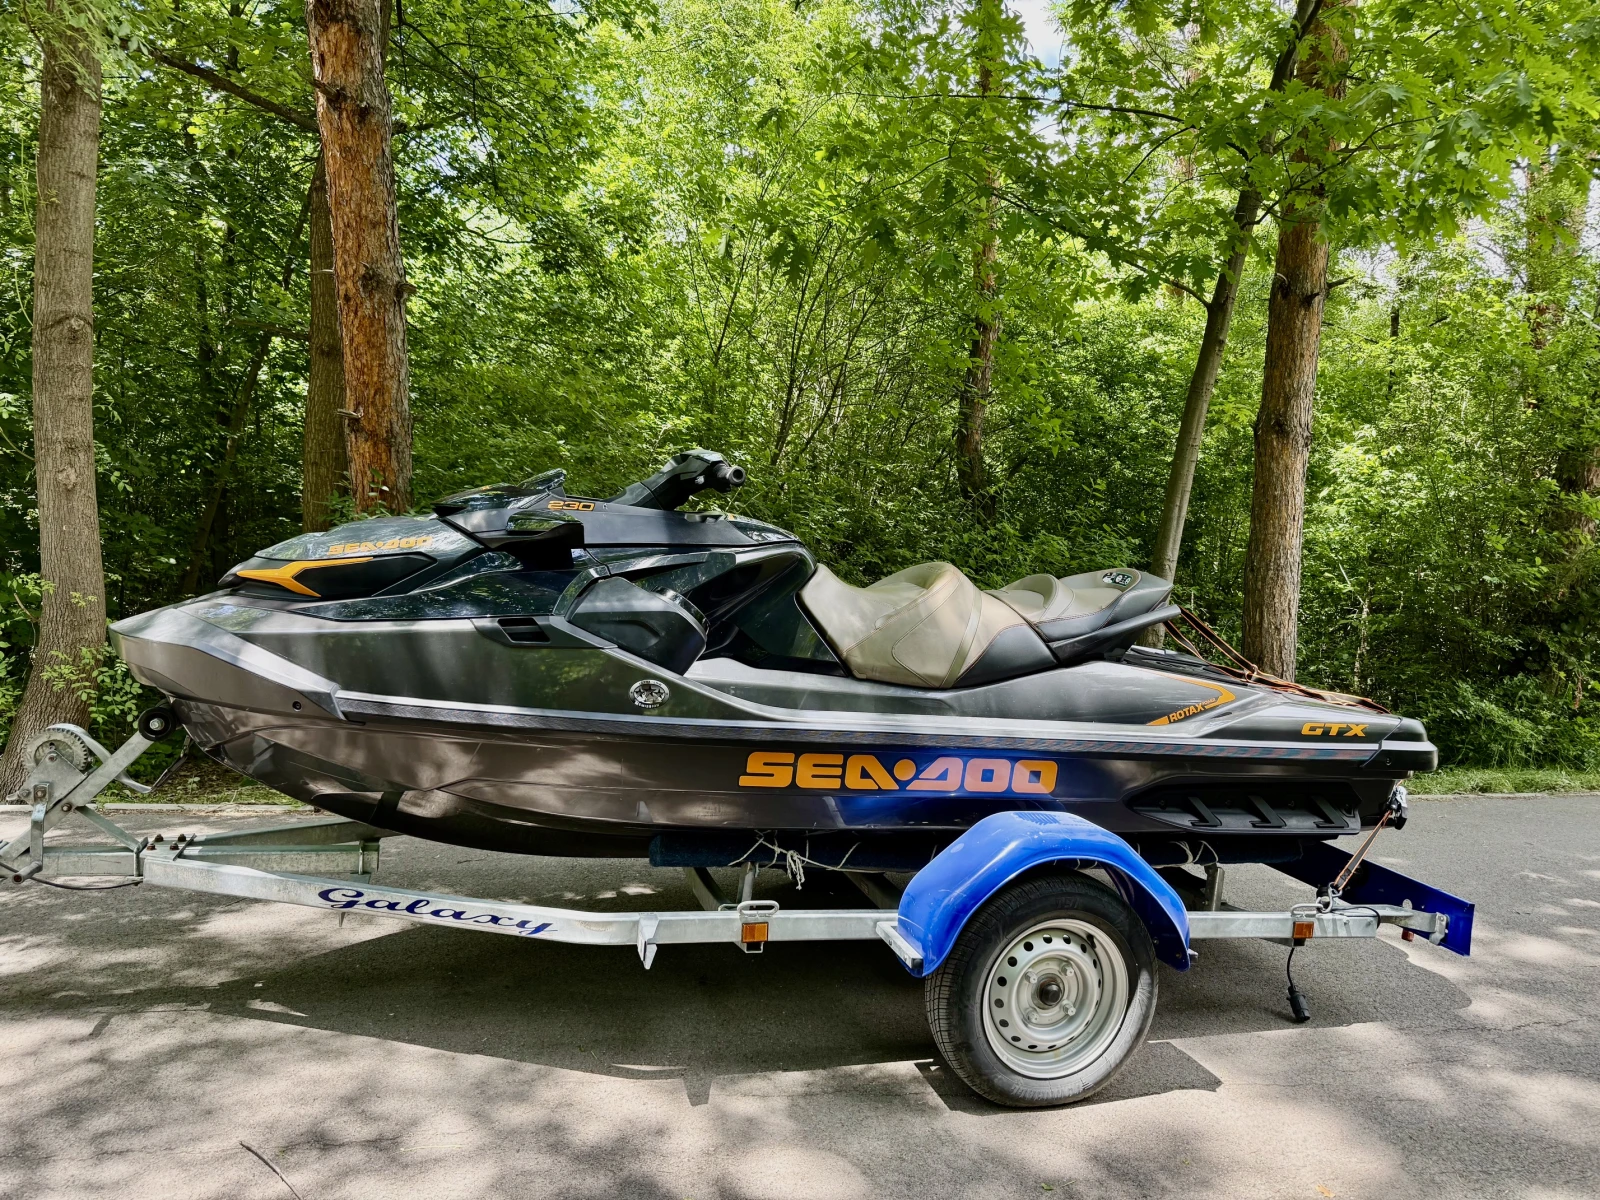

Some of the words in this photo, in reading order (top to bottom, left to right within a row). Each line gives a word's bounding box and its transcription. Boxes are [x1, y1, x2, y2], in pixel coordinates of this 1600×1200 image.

[547, 500, 596, 512] 230
[1169, 703, 1205, 722] ROTAX
[1301, 722, 1370, 737] GTX
[318, 888, 558, 936] Galaxy
